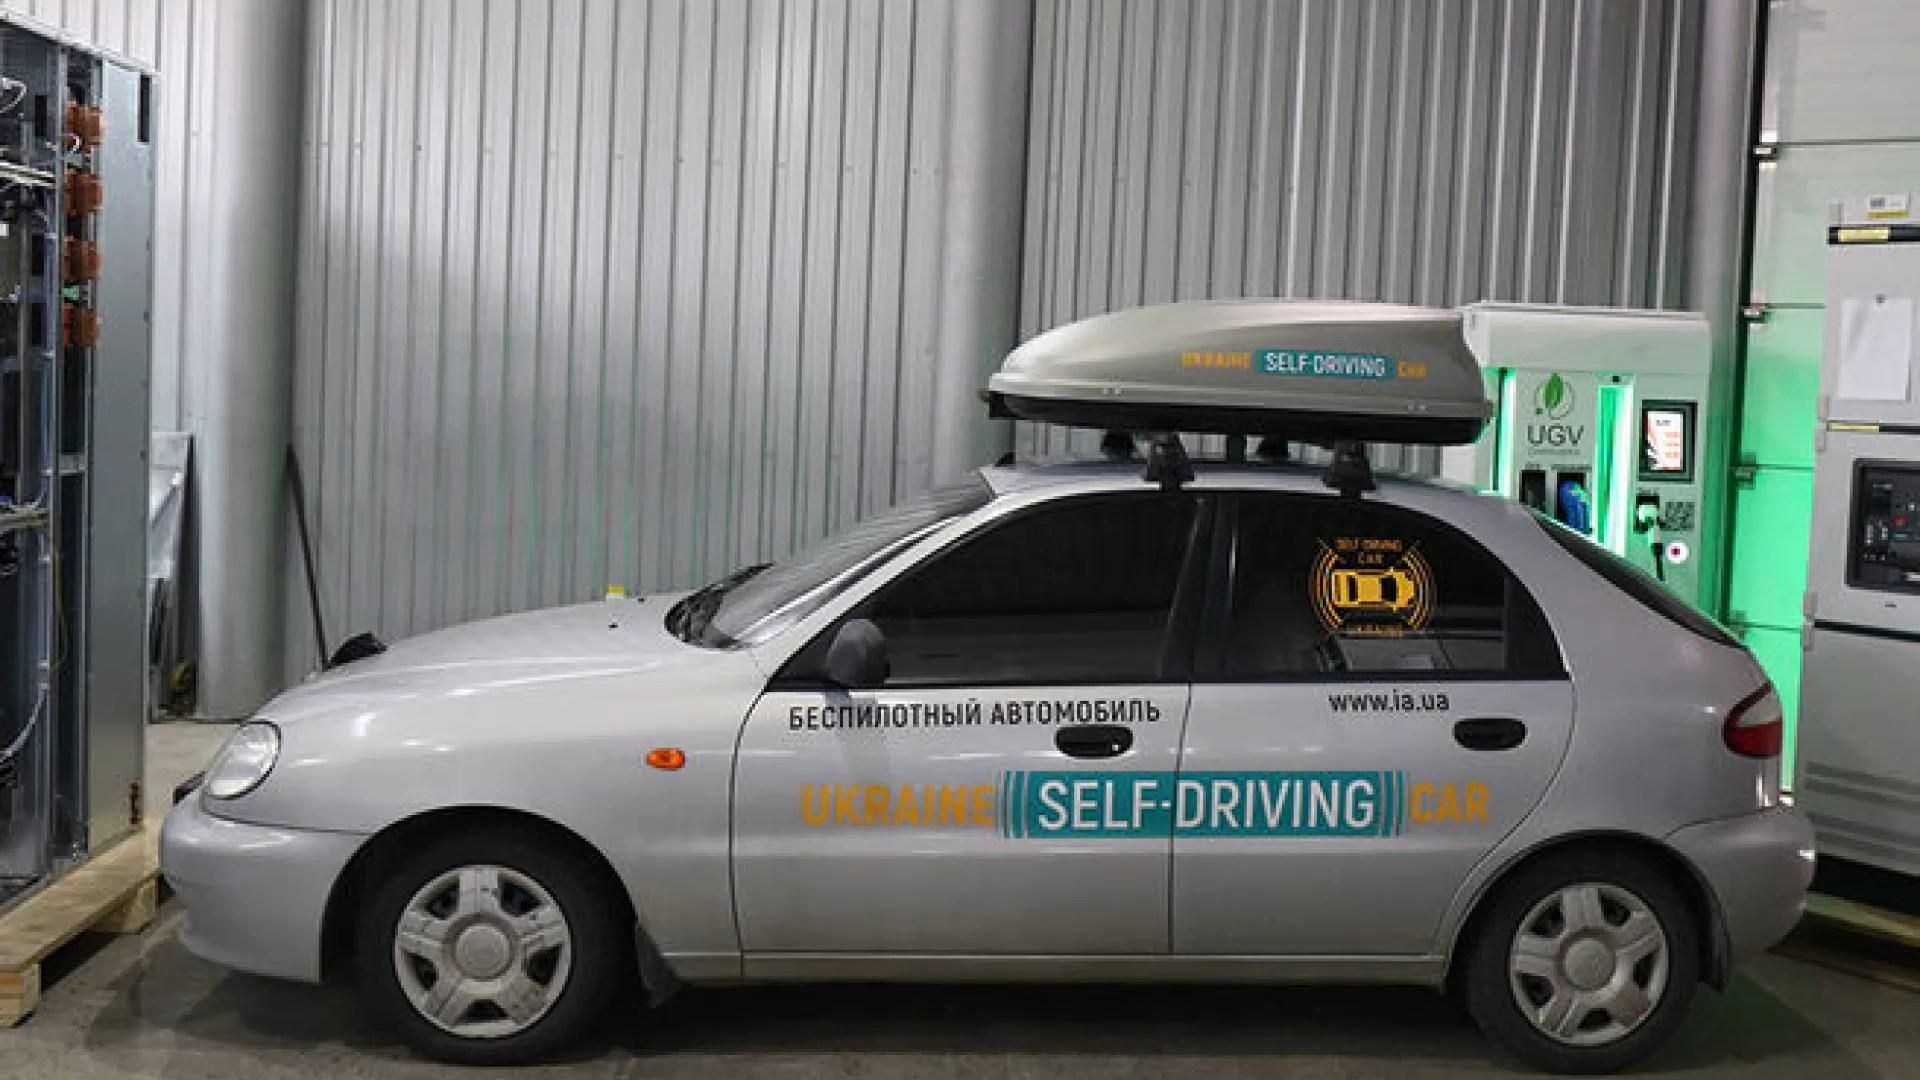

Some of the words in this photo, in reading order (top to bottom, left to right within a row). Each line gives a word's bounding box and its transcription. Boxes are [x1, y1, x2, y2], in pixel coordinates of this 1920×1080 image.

[1527, 424, 1584, 446] UGV
[789, 697, 981, 730] БЕСПИЛОТНЫЙ
[990, 699, 1160, 724] АВТОМОБИЛЬ
[1328, 688, 1450, 712] www.ia.ua
[801, 783, 995, 827] UKRAINE
[1038, 779, 1375, 830] SELF-DRIVING
[1410, 782, 1489, 825] CAR
